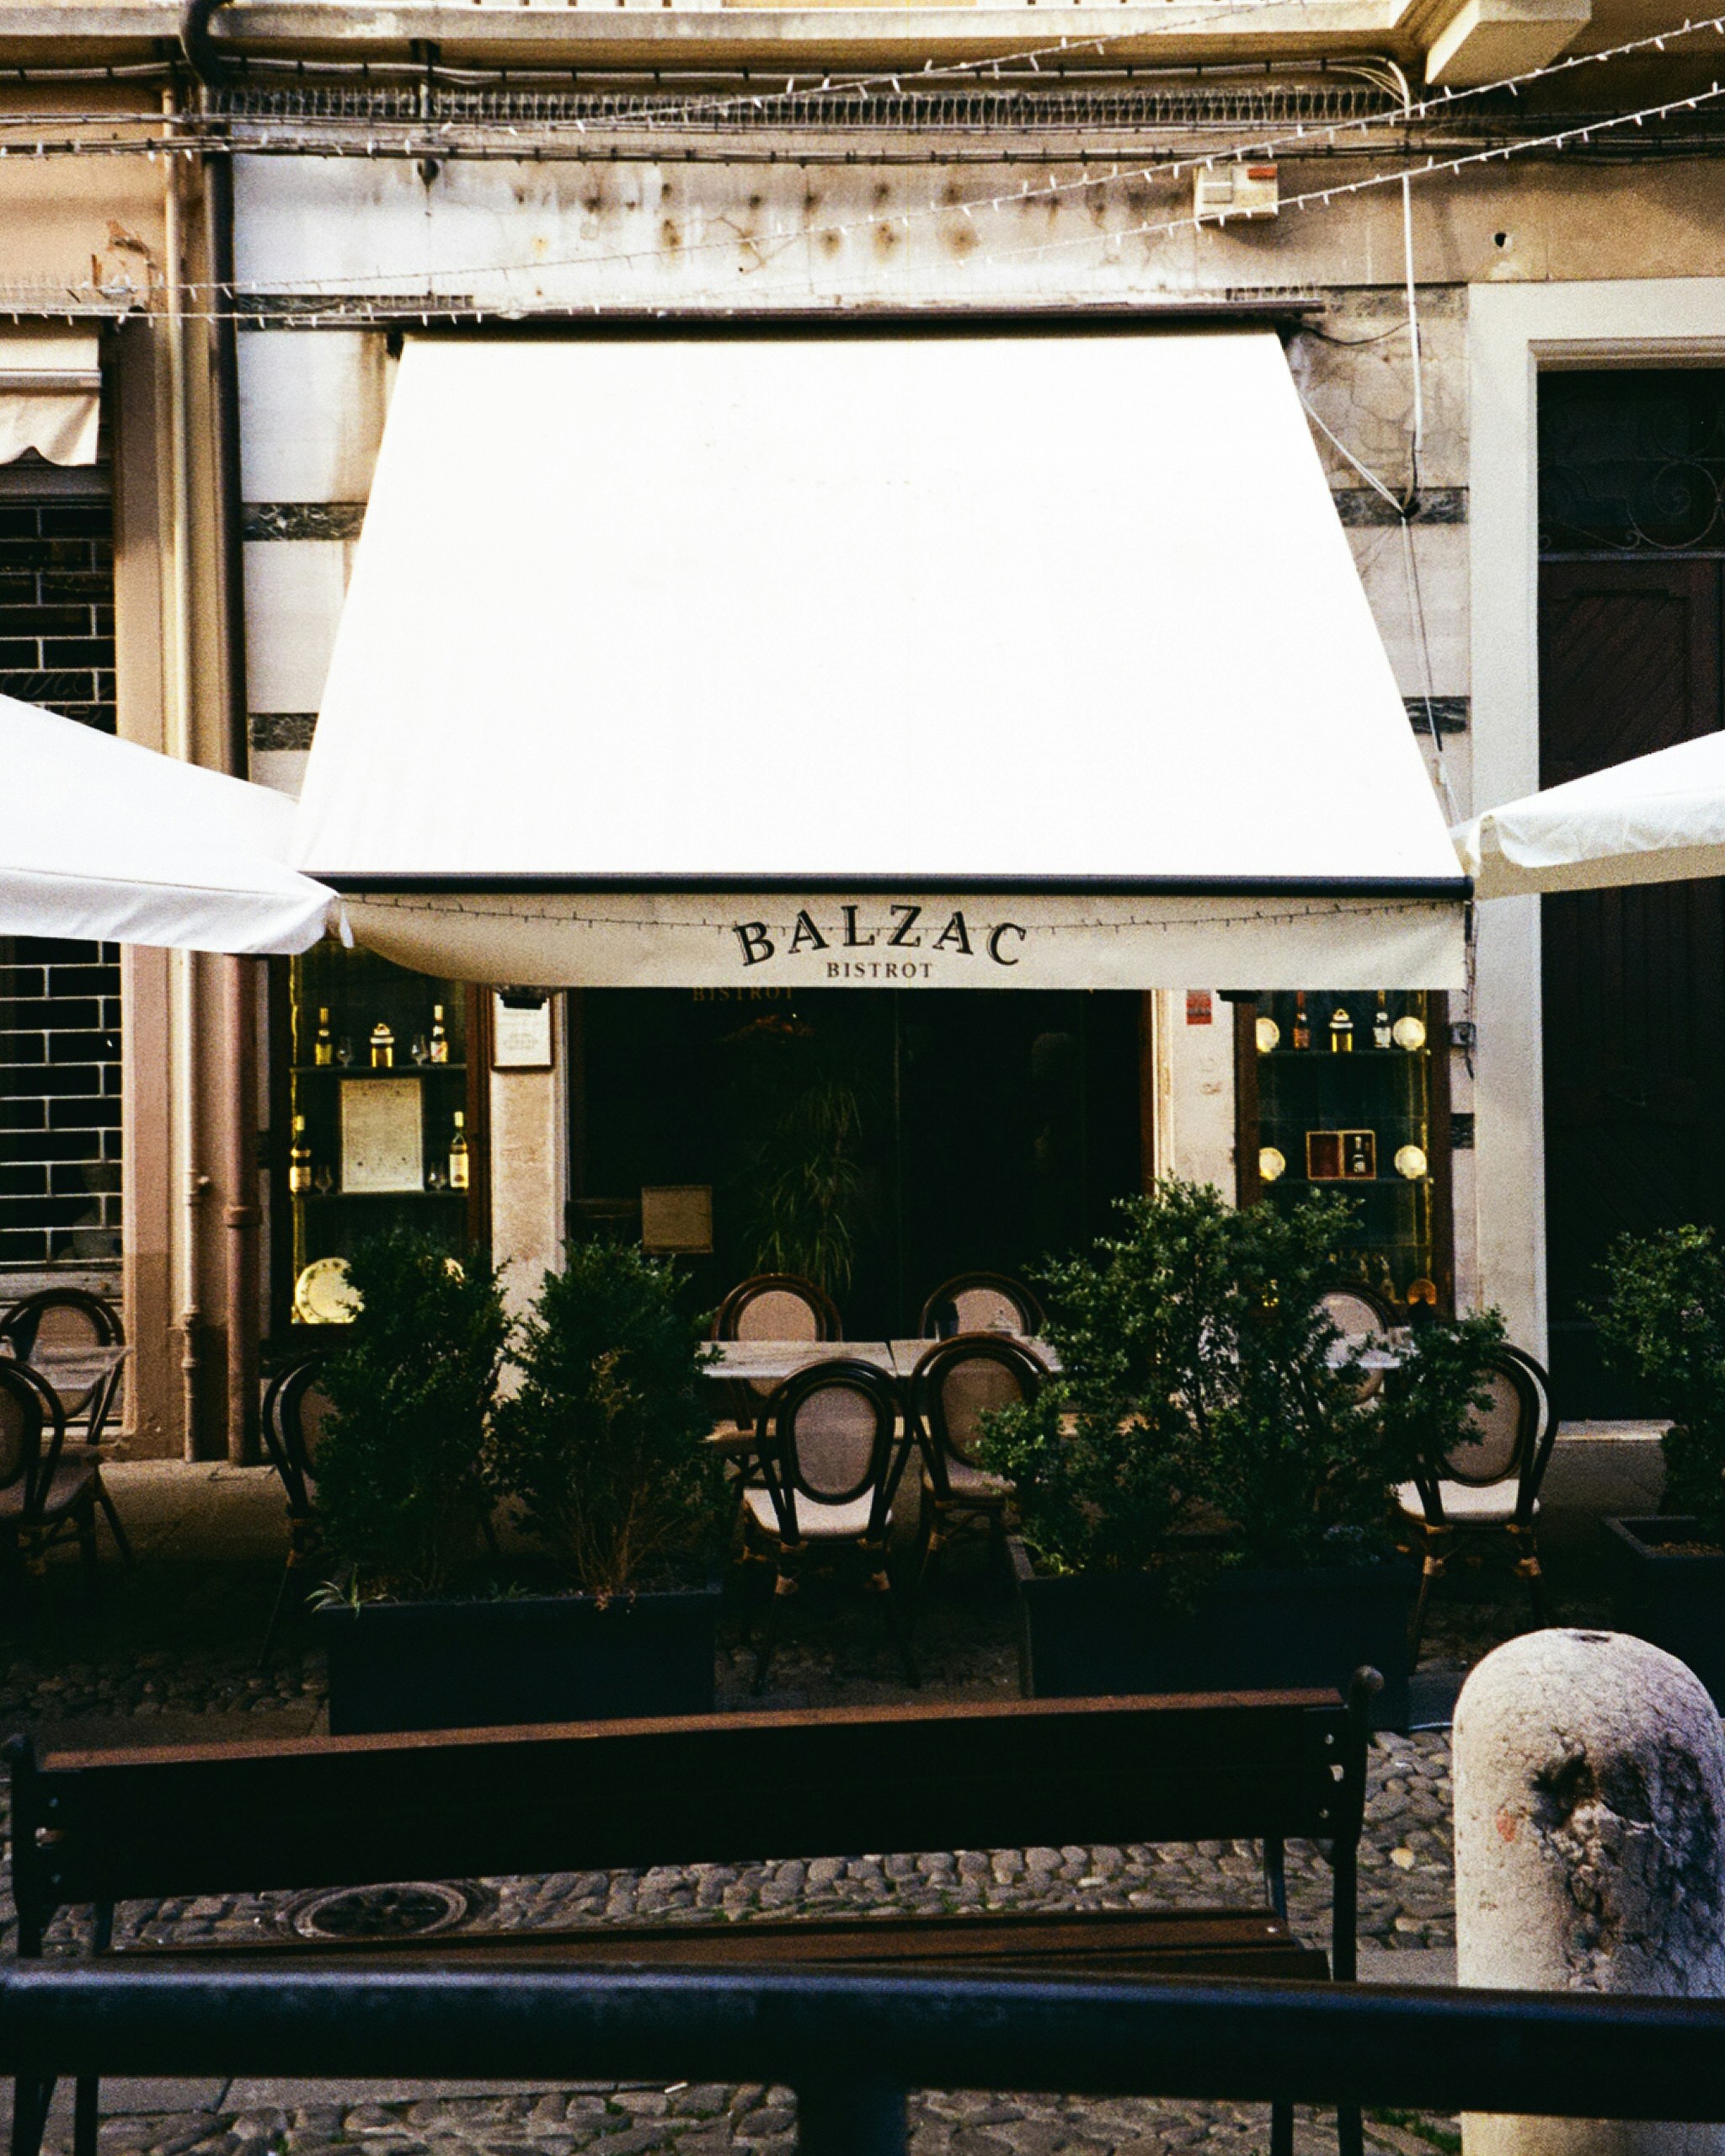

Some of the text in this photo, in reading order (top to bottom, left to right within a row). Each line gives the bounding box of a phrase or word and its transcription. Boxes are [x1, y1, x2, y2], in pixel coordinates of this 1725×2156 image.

[733, 905, 1027, 967] BALZAC
[826, 963, 933, 978] BISTROT
[692, 988, 793, 1001] BISTROT
